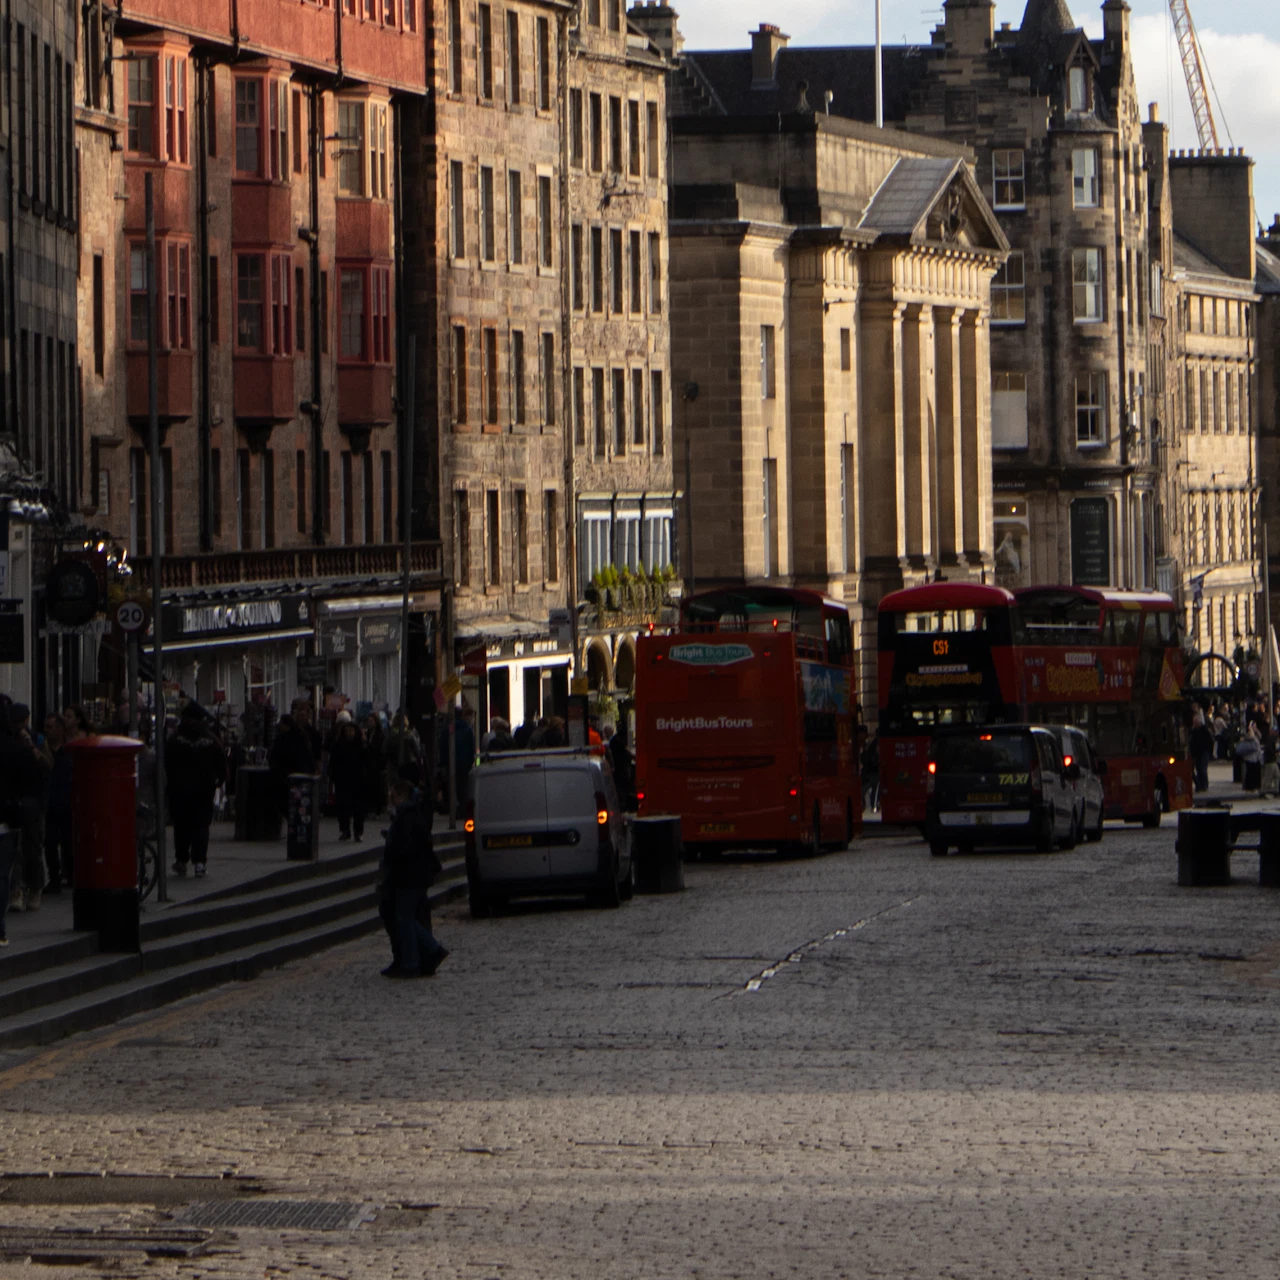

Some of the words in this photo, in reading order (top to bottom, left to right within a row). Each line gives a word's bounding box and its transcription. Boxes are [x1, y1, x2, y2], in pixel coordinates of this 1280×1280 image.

[120, 608, 142, 623] 20
[673, 647, 703, 659] Bright
[706, 648, 722, 657] Bus
[932, 639, 949, 656] CS1
[656, 716, 753, 732] BrightBusTours
[999, 773, 1030, 785] TAXI
